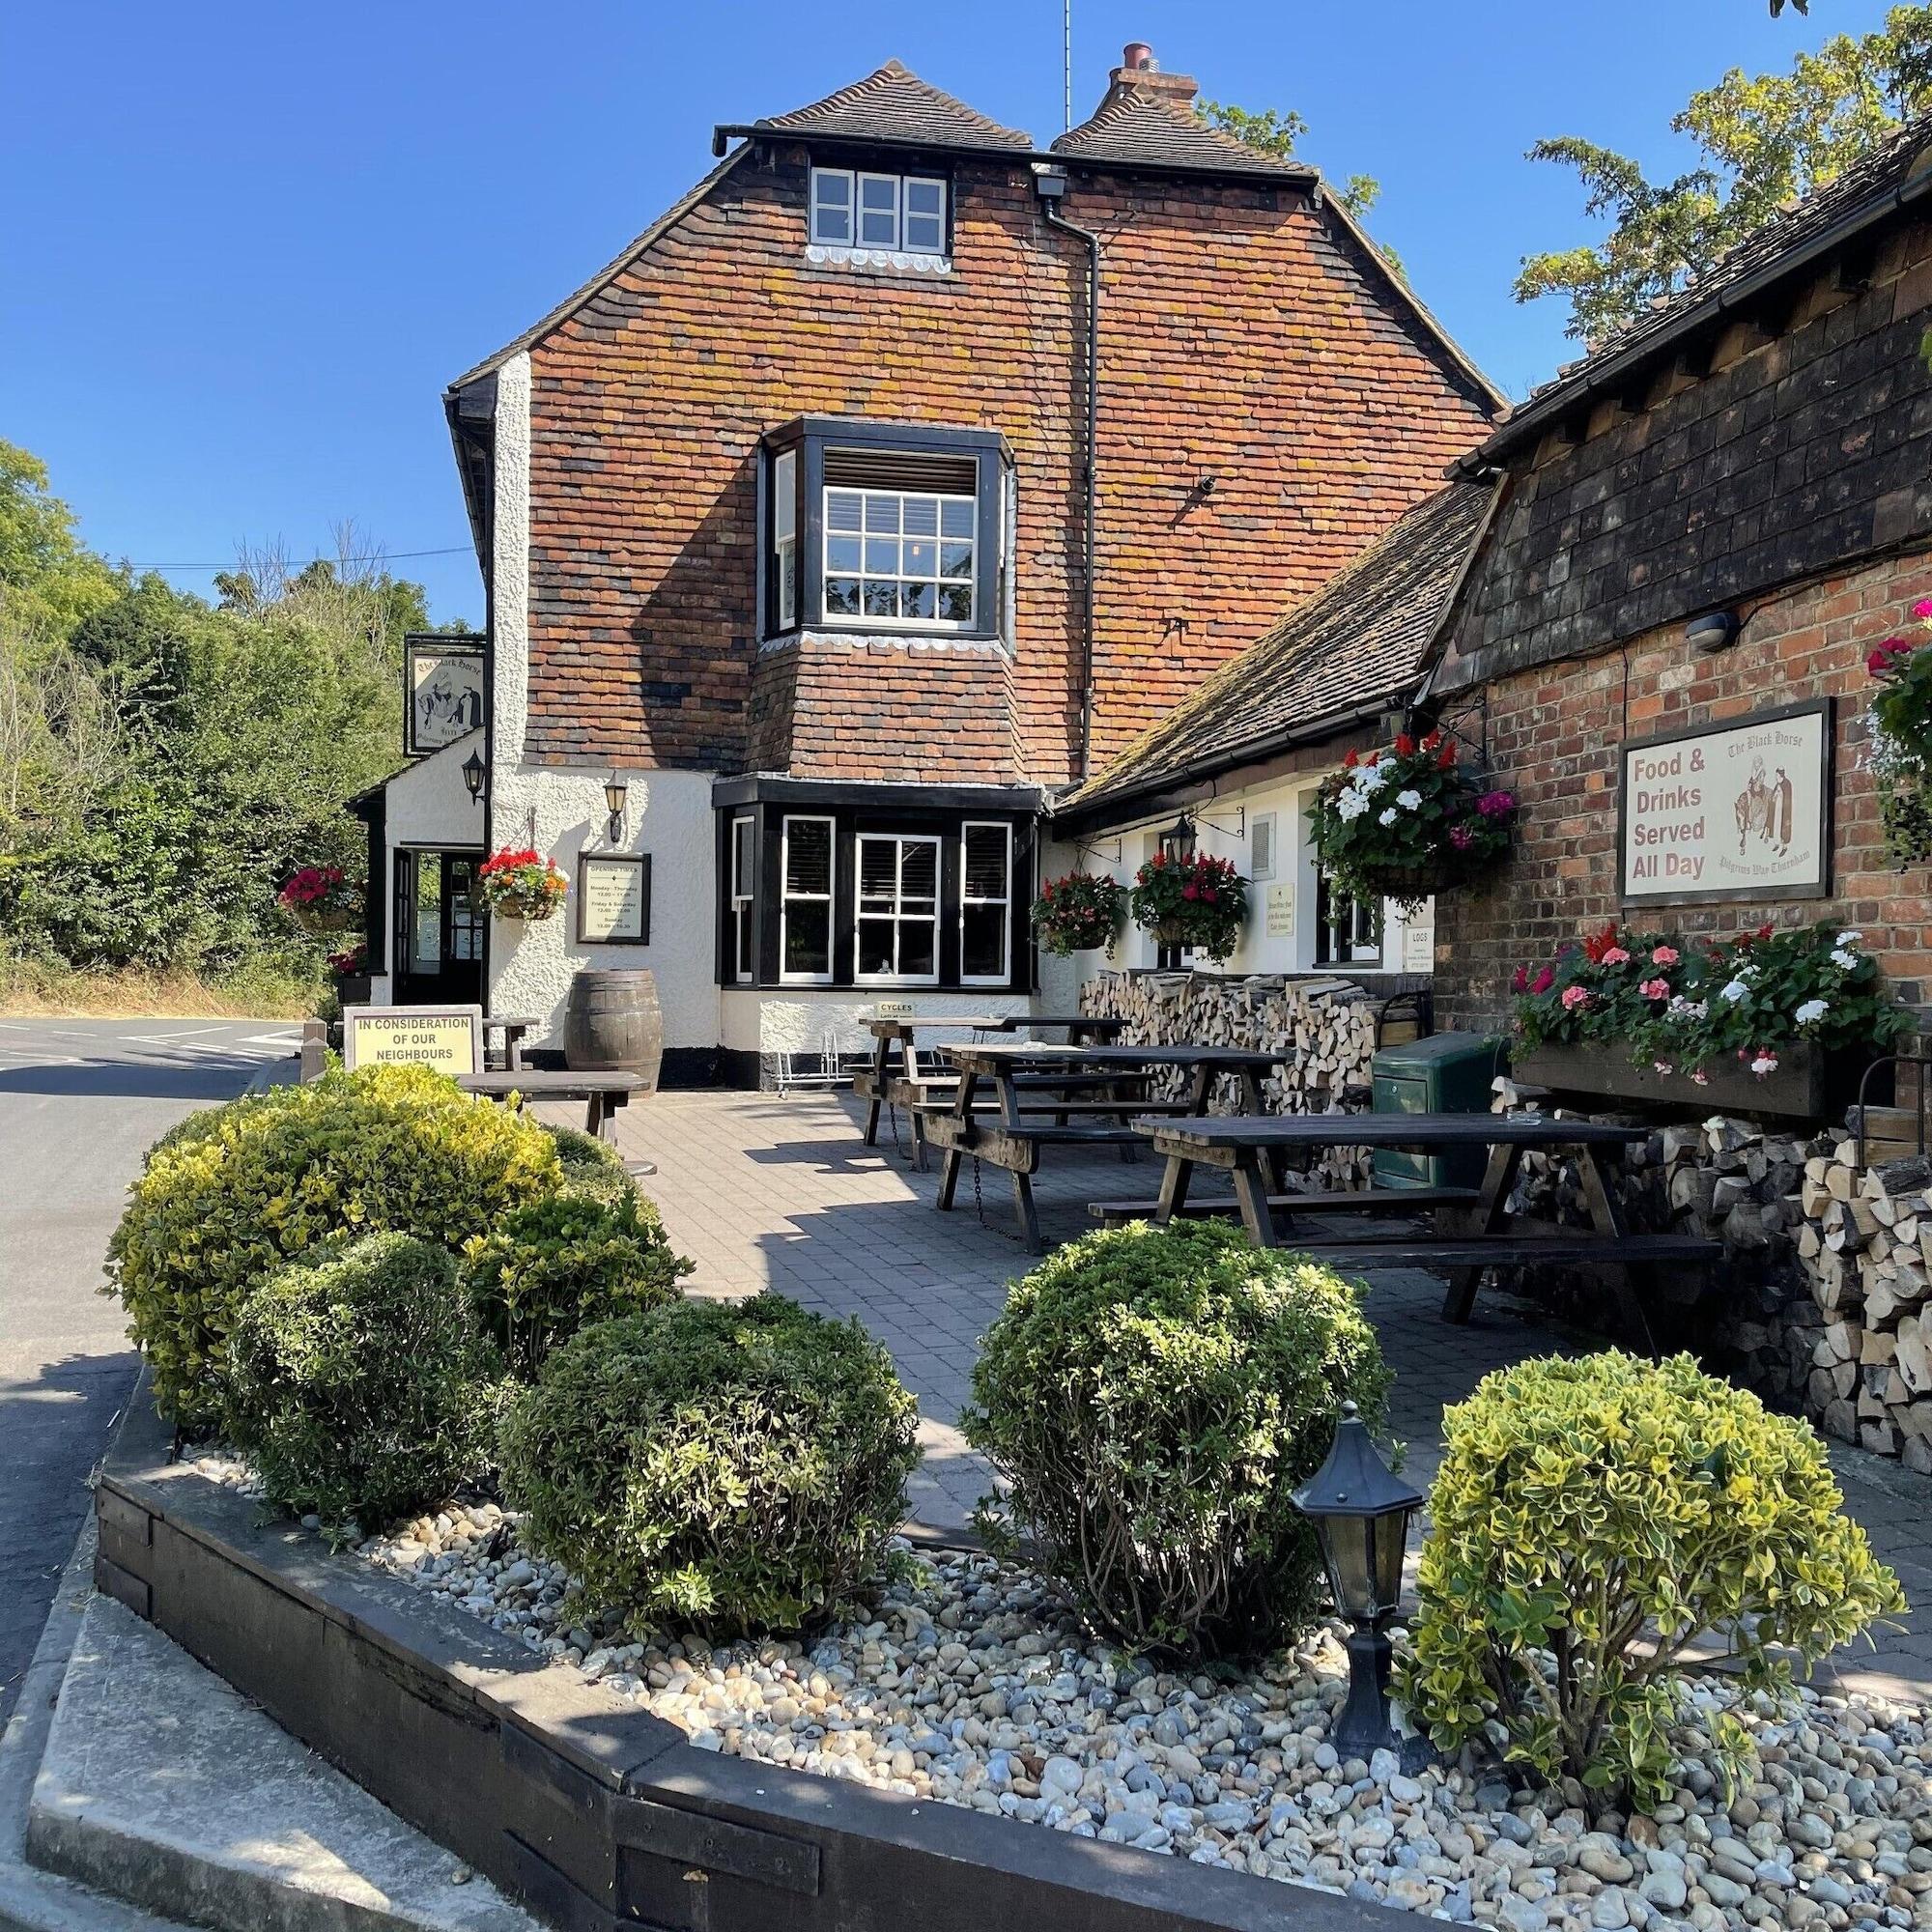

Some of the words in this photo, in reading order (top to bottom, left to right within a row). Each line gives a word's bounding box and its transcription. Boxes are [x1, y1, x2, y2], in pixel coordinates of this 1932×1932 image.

[1728, 743, 1745, 758] The
[1747, 734, 1773, 750] Black
[1775, 730, 1803, 747] Horse
[1634, 752, 1681, 781] Food
[1690, 748, 1705, 772] &
[1636, 785, 1702, 814] Drinks
[1634, 816, 1705, 846] Served
[1633, 855, 1659, 879] All
[1665, 852, 1705, 881] Day
[359, 1019, 371, 1030] IN
[375, 1018, 469, 1030] CONSIDERATION
[393, 1035, 408, 1044] OF
[412, 1034, 437, 1044] OUR
[377, 1049, 453, 1060] NEIGHBOURS
